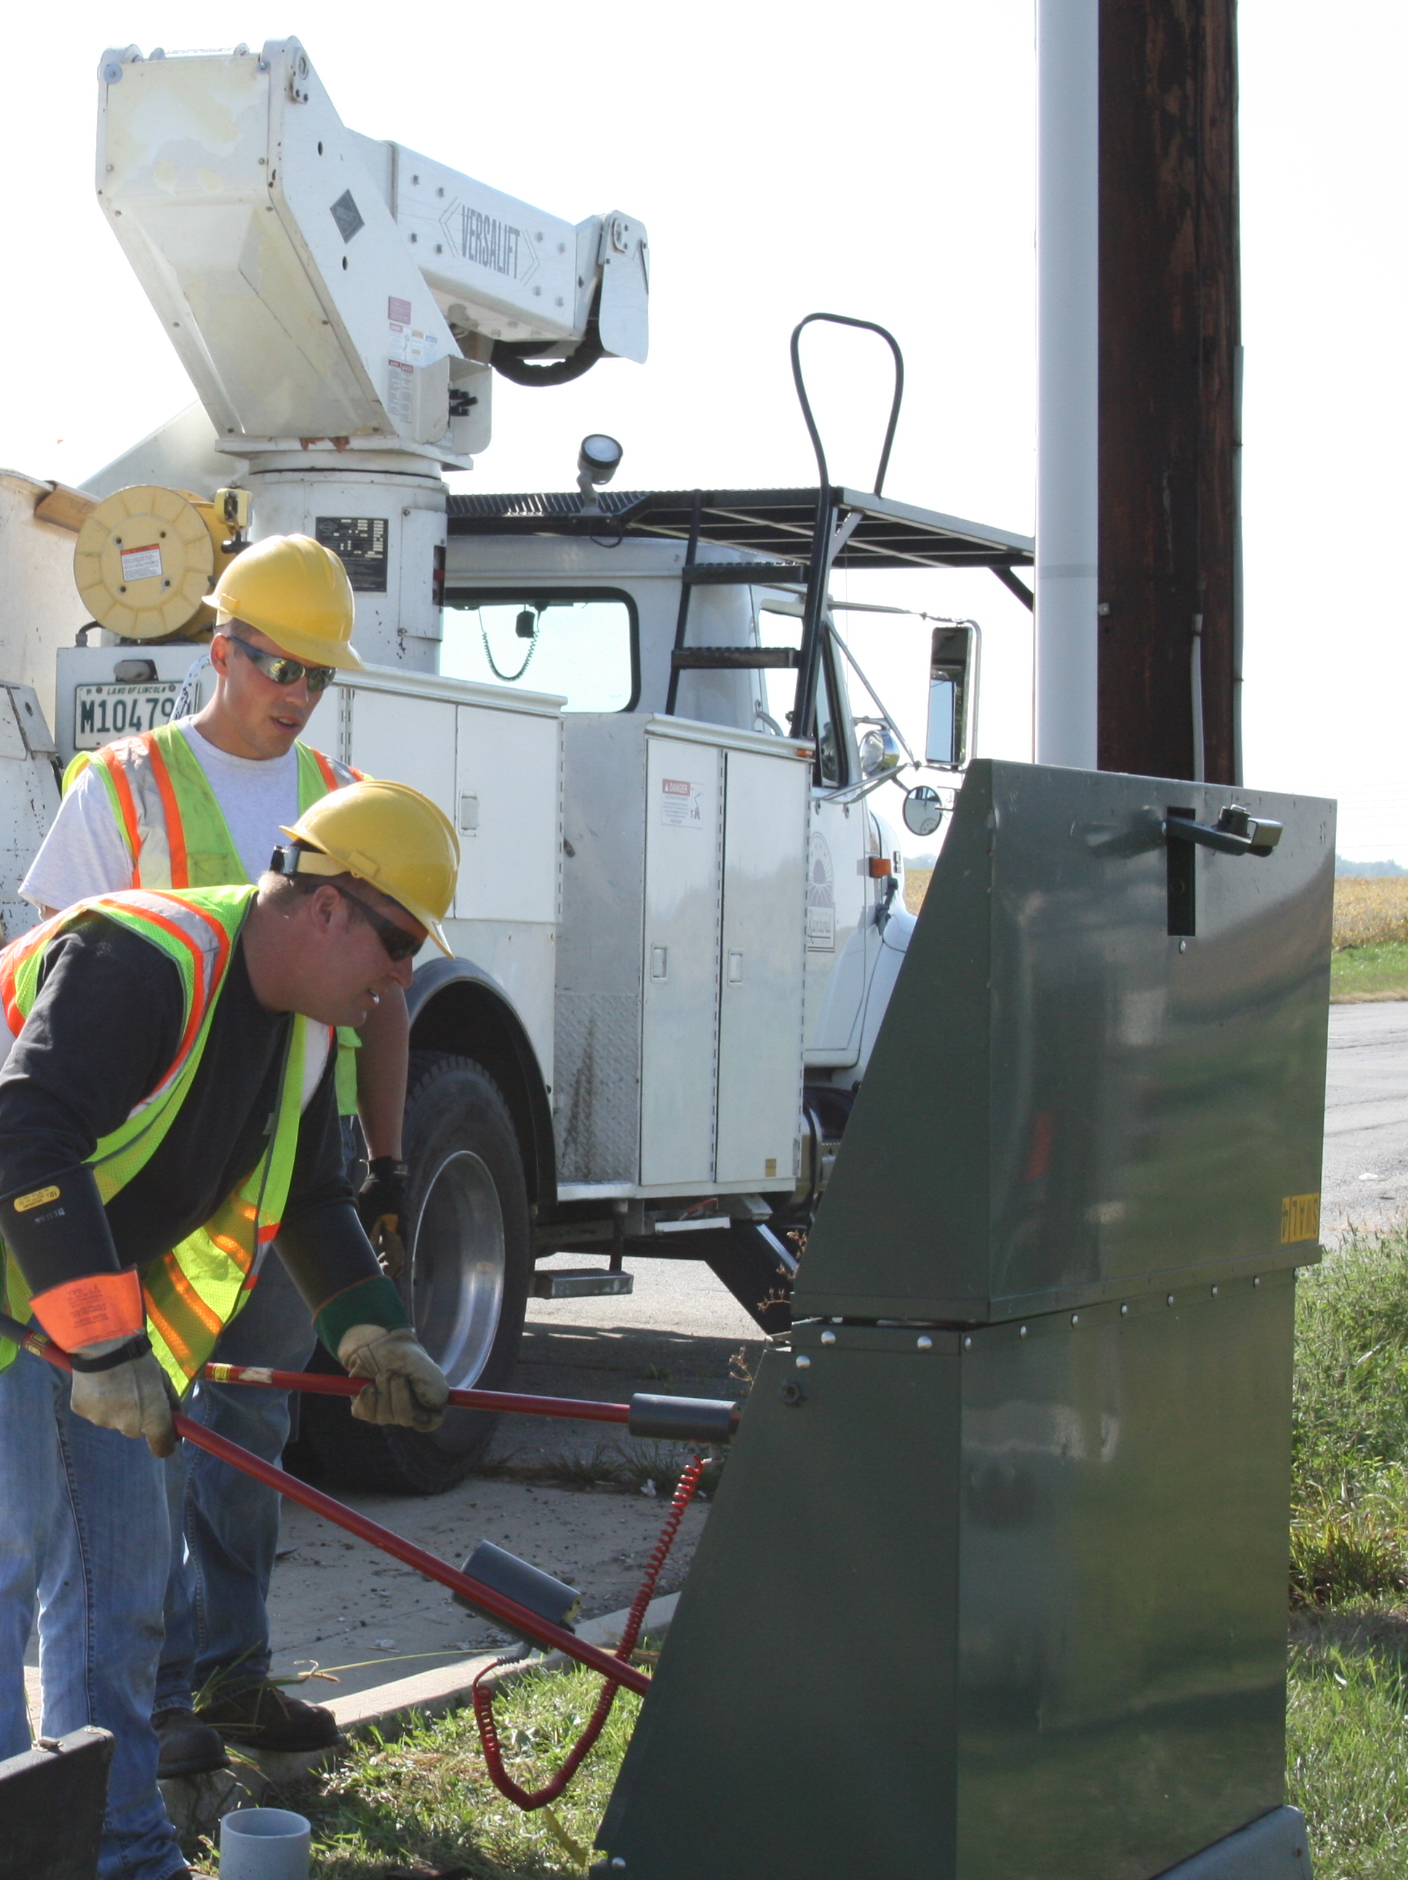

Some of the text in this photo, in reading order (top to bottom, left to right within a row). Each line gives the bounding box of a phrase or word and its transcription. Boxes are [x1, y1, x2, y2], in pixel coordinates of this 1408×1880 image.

[461, 204, 520, 279] VERSALIFT
[107, 687, 126, 695] LAND
[137, 686, 167, 694] LINCOLN
[80, 697, 191, 734] M10479
